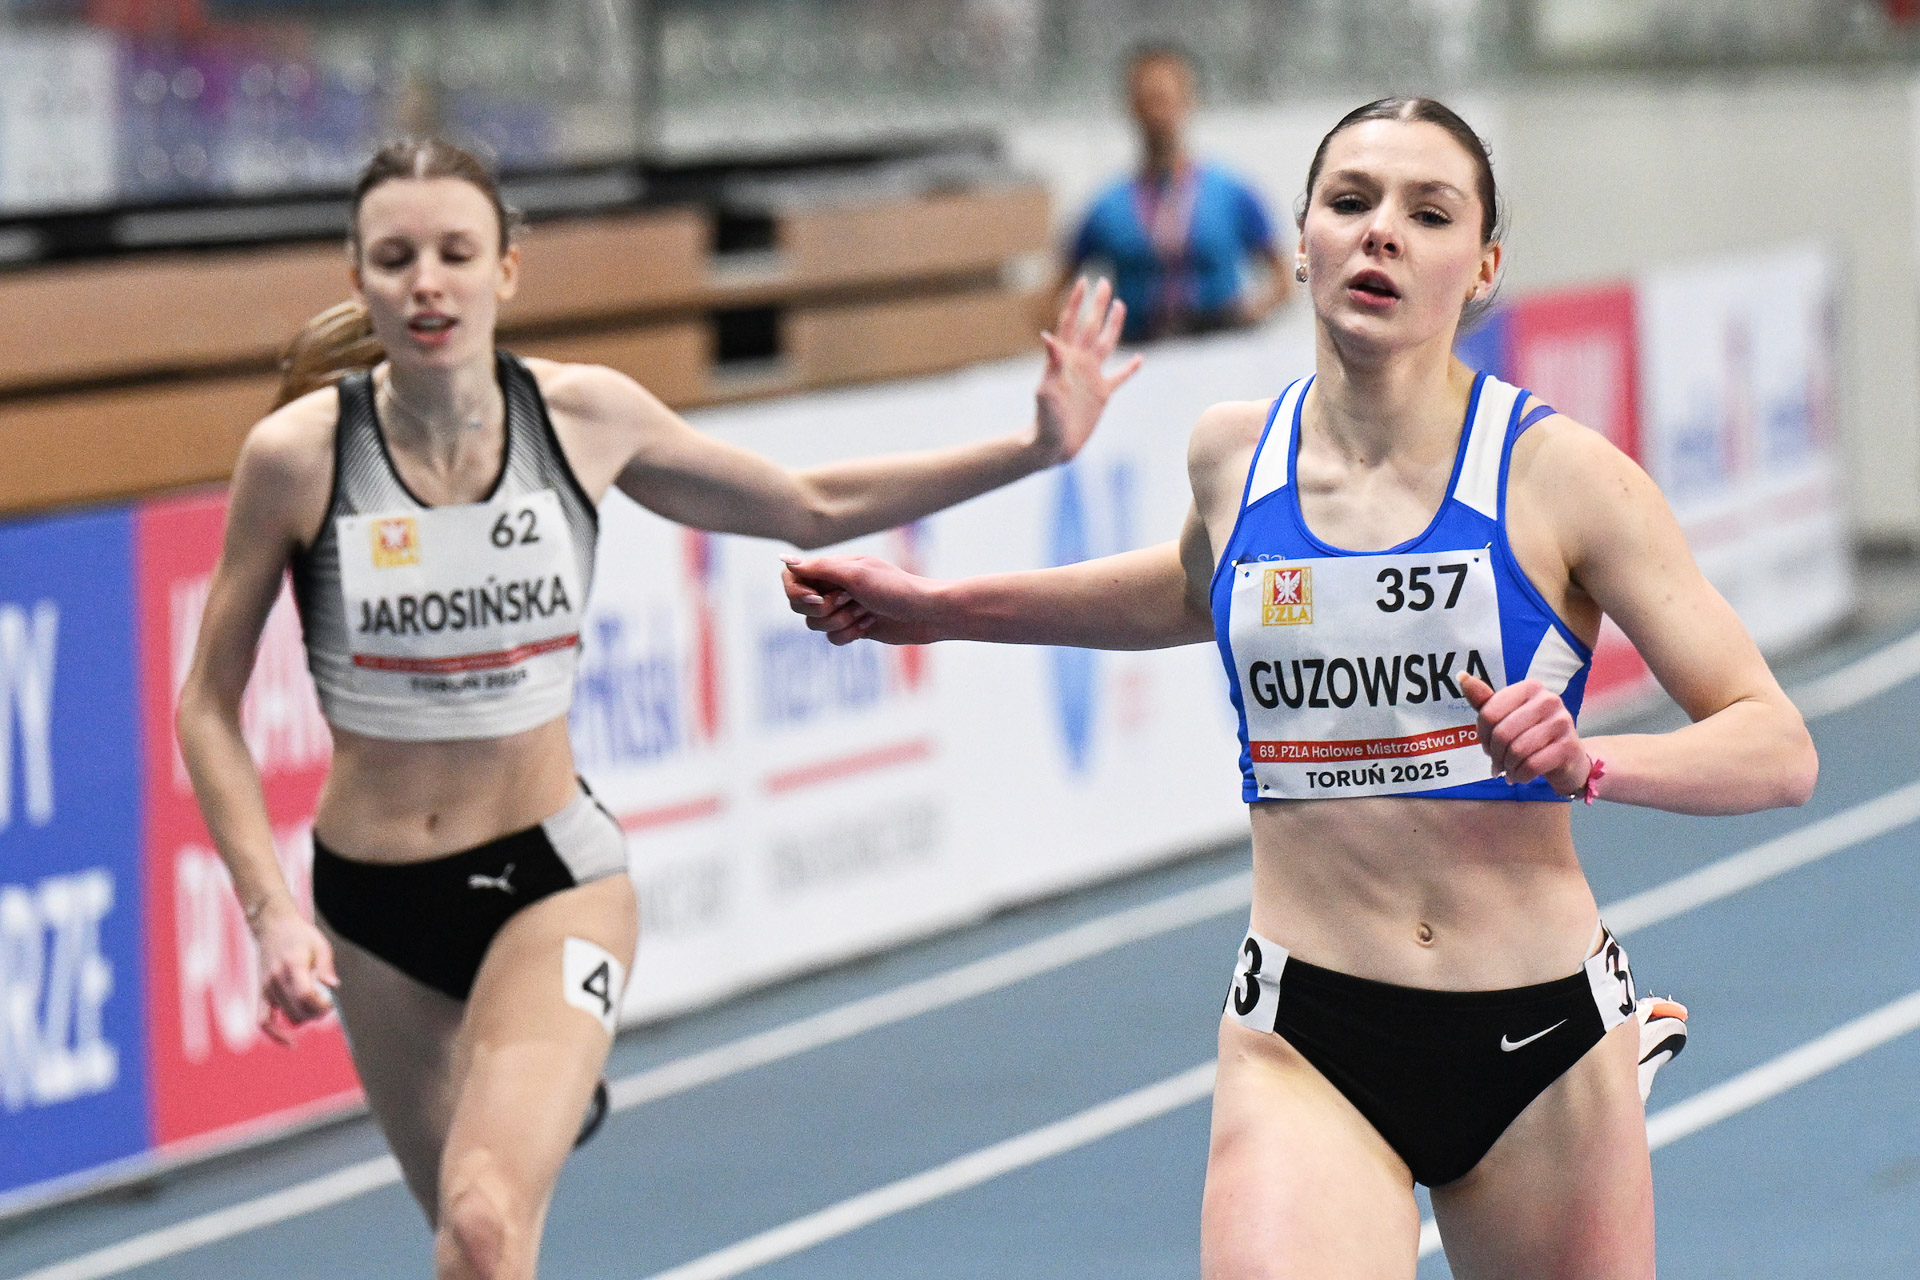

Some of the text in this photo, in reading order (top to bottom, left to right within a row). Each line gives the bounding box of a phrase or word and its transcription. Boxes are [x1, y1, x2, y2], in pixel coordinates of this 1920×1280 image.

[491, 509, 541, 549] 62
[359, 574, 572, 636] JAROSIŃSKA
[1265, 605, 1310, 623] PZLA
[1376, 563, 1469, 613] 357
[1250, 649, 1497, 709] GUZOWSKA
[1259, 729, 1478, 758] 69. PZLA Halowe Mistrzostwa Po
[1306, 759, 1450, 789] TORUŃ 2025
[582, 961, 612, 1016] 4
[1234, 937, 1262, 1016] 3
[1605, 942, 1634, 1017] 3
